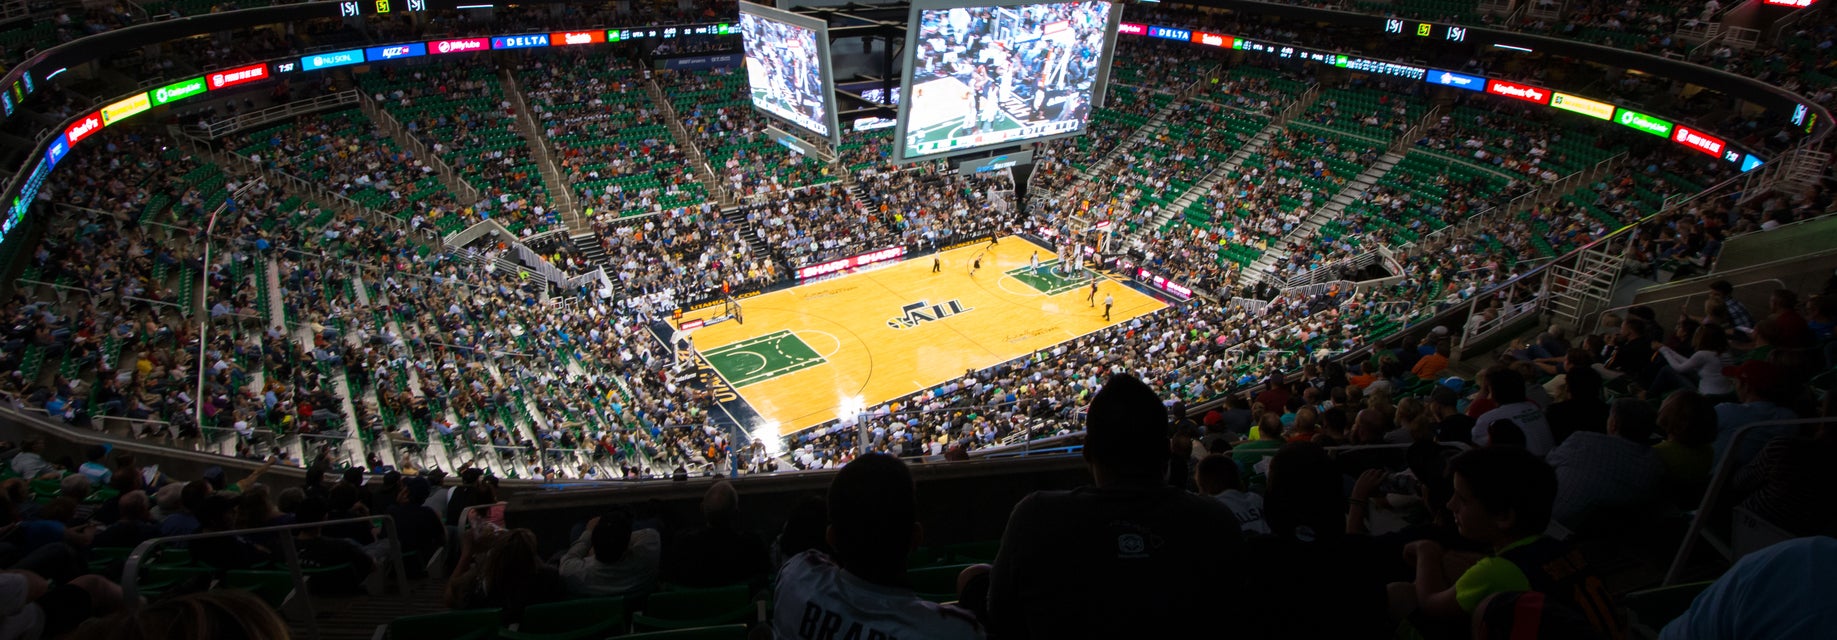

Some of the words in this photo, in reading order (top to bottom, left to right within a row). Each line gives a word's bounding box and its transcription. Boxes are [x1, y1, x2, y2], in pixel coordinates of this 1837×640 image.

[506, 36, 547, 46] DELTA
[1158, 29, 1188, 39] DELTA
[857, 247, 900, 264] SHARP
[803, 259, 849, 277] SHARP
[799, 601, 897, 640] BRA
